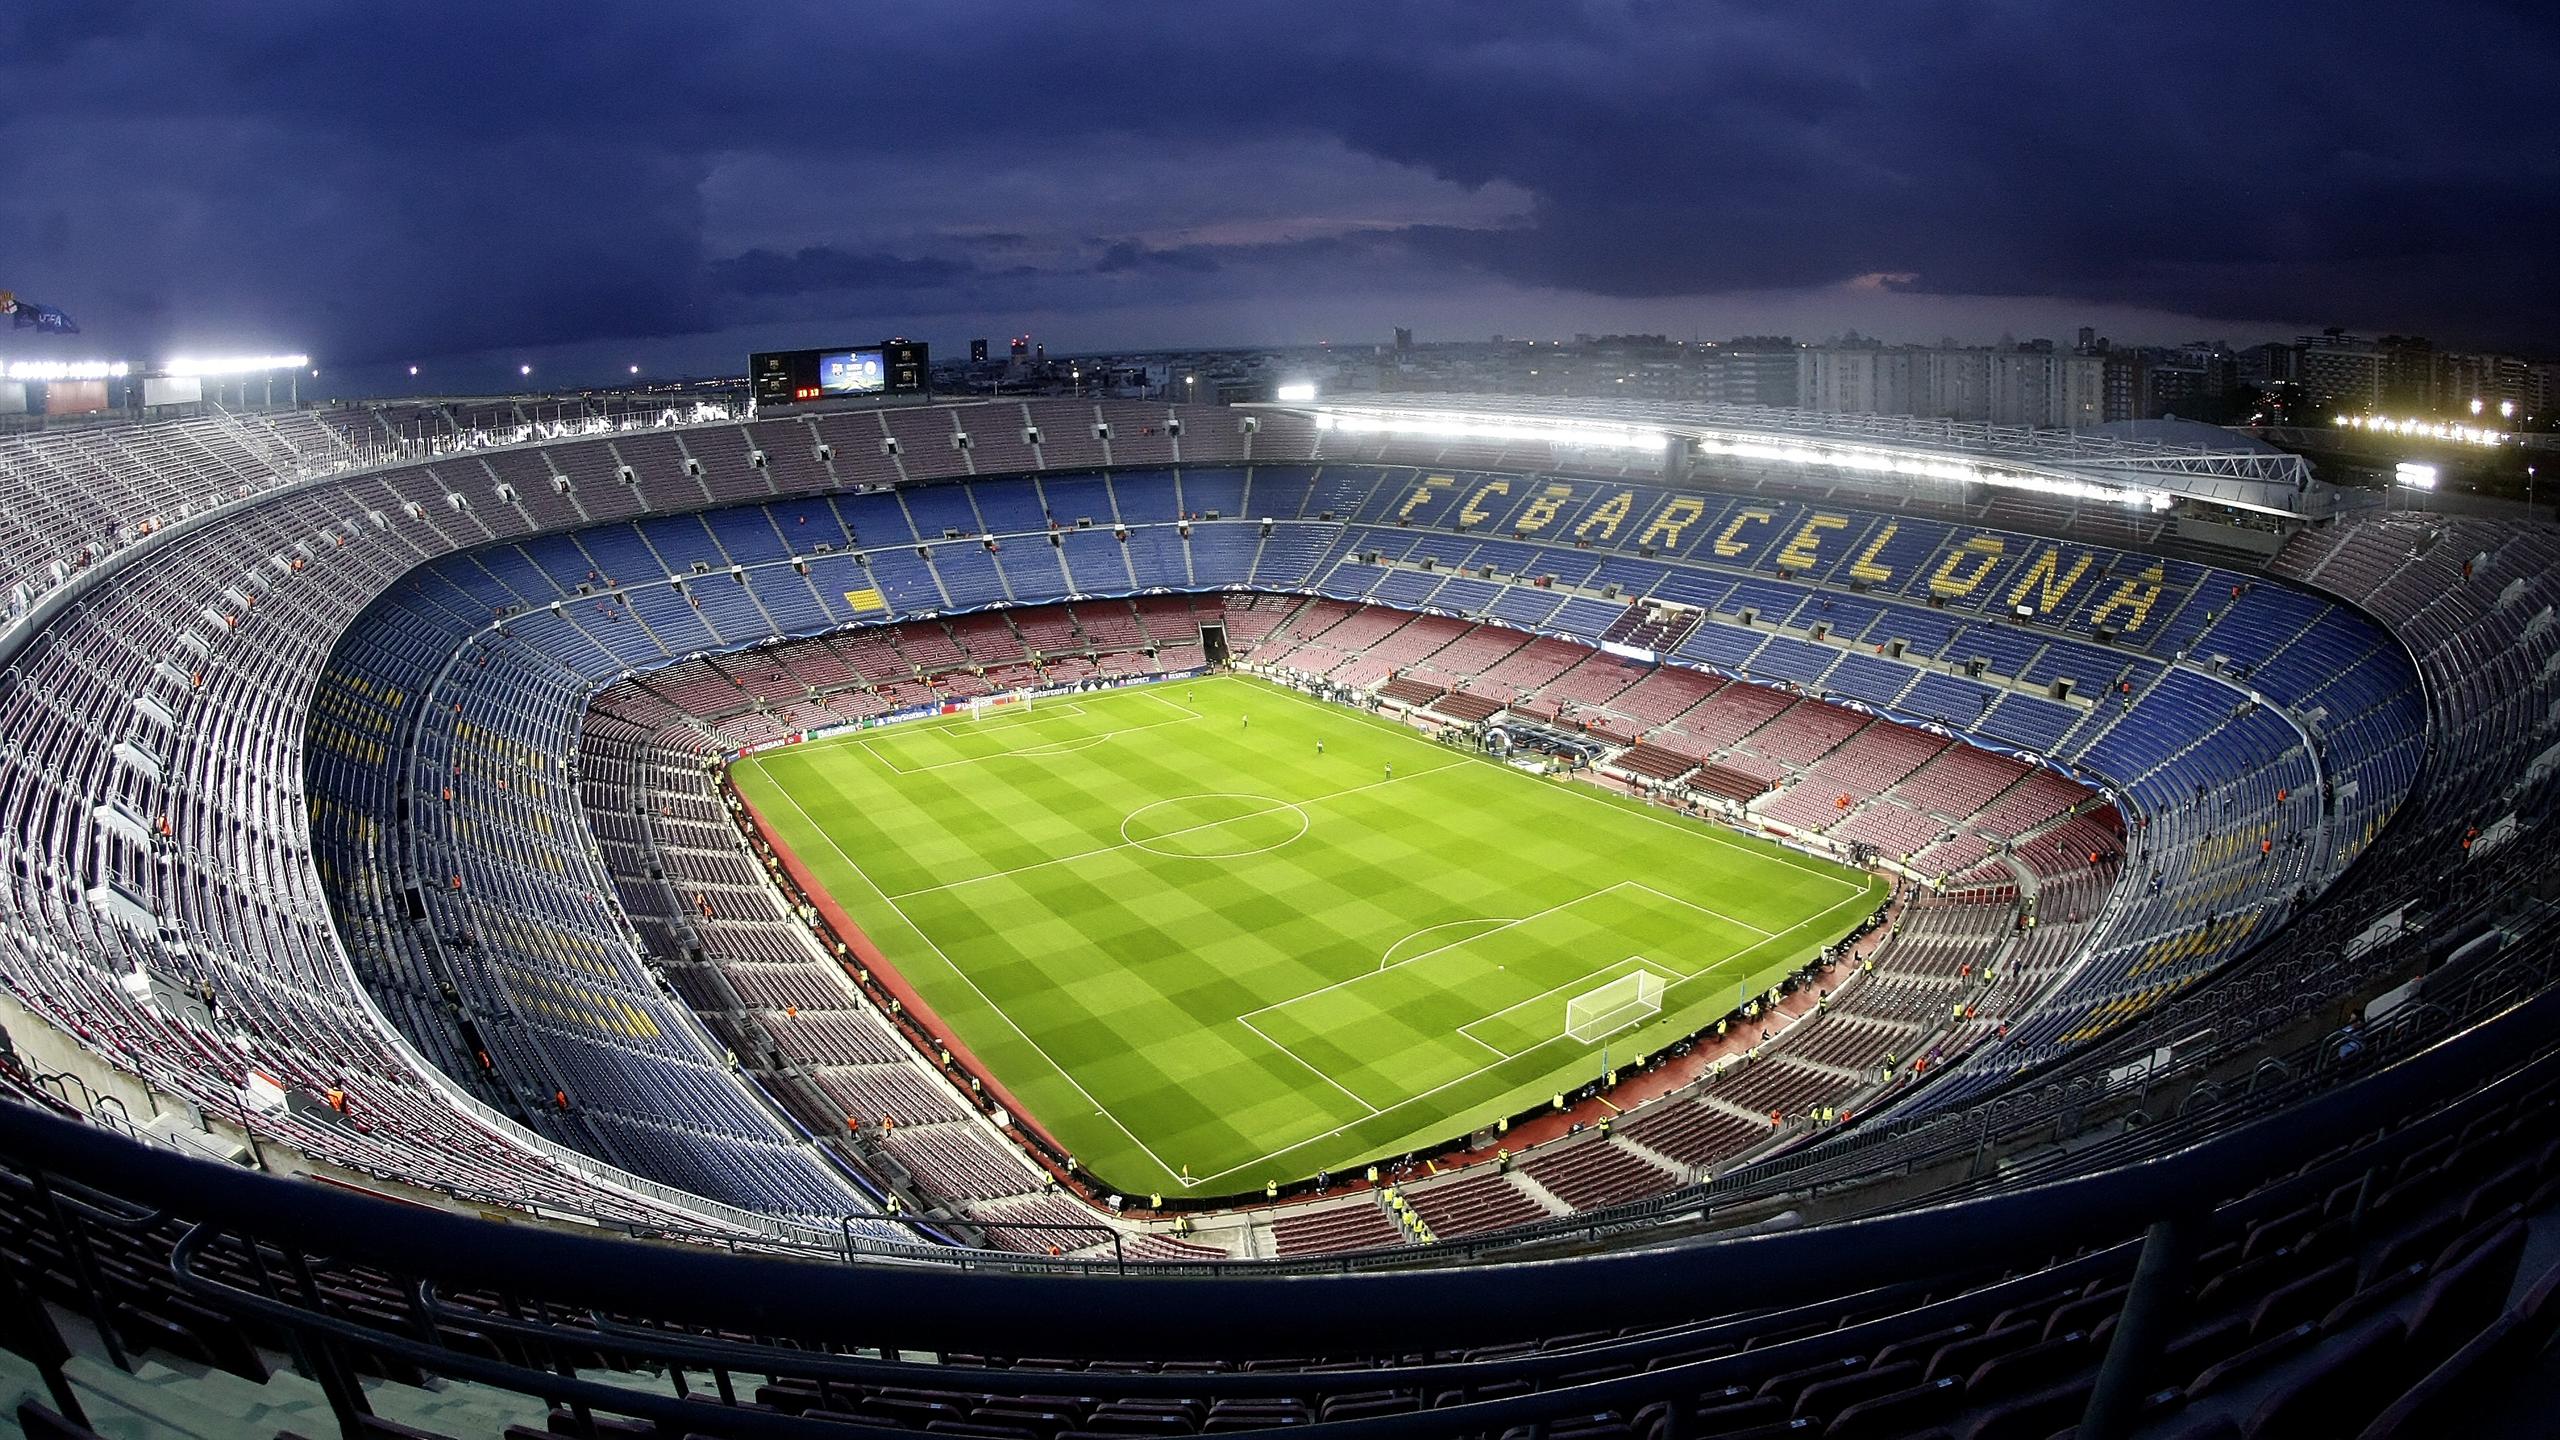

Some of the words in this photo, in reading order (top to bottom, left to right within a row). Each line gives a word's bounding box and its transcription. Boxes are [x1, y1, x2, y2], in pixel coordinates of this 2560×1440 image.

[1126, 676, 1150, 686] RESPECT
[1168, 671, 1192, 680] RESPECT
[886, 710, 928, 723] PlayStation
[753, 739, 786, 752] NISSAN
